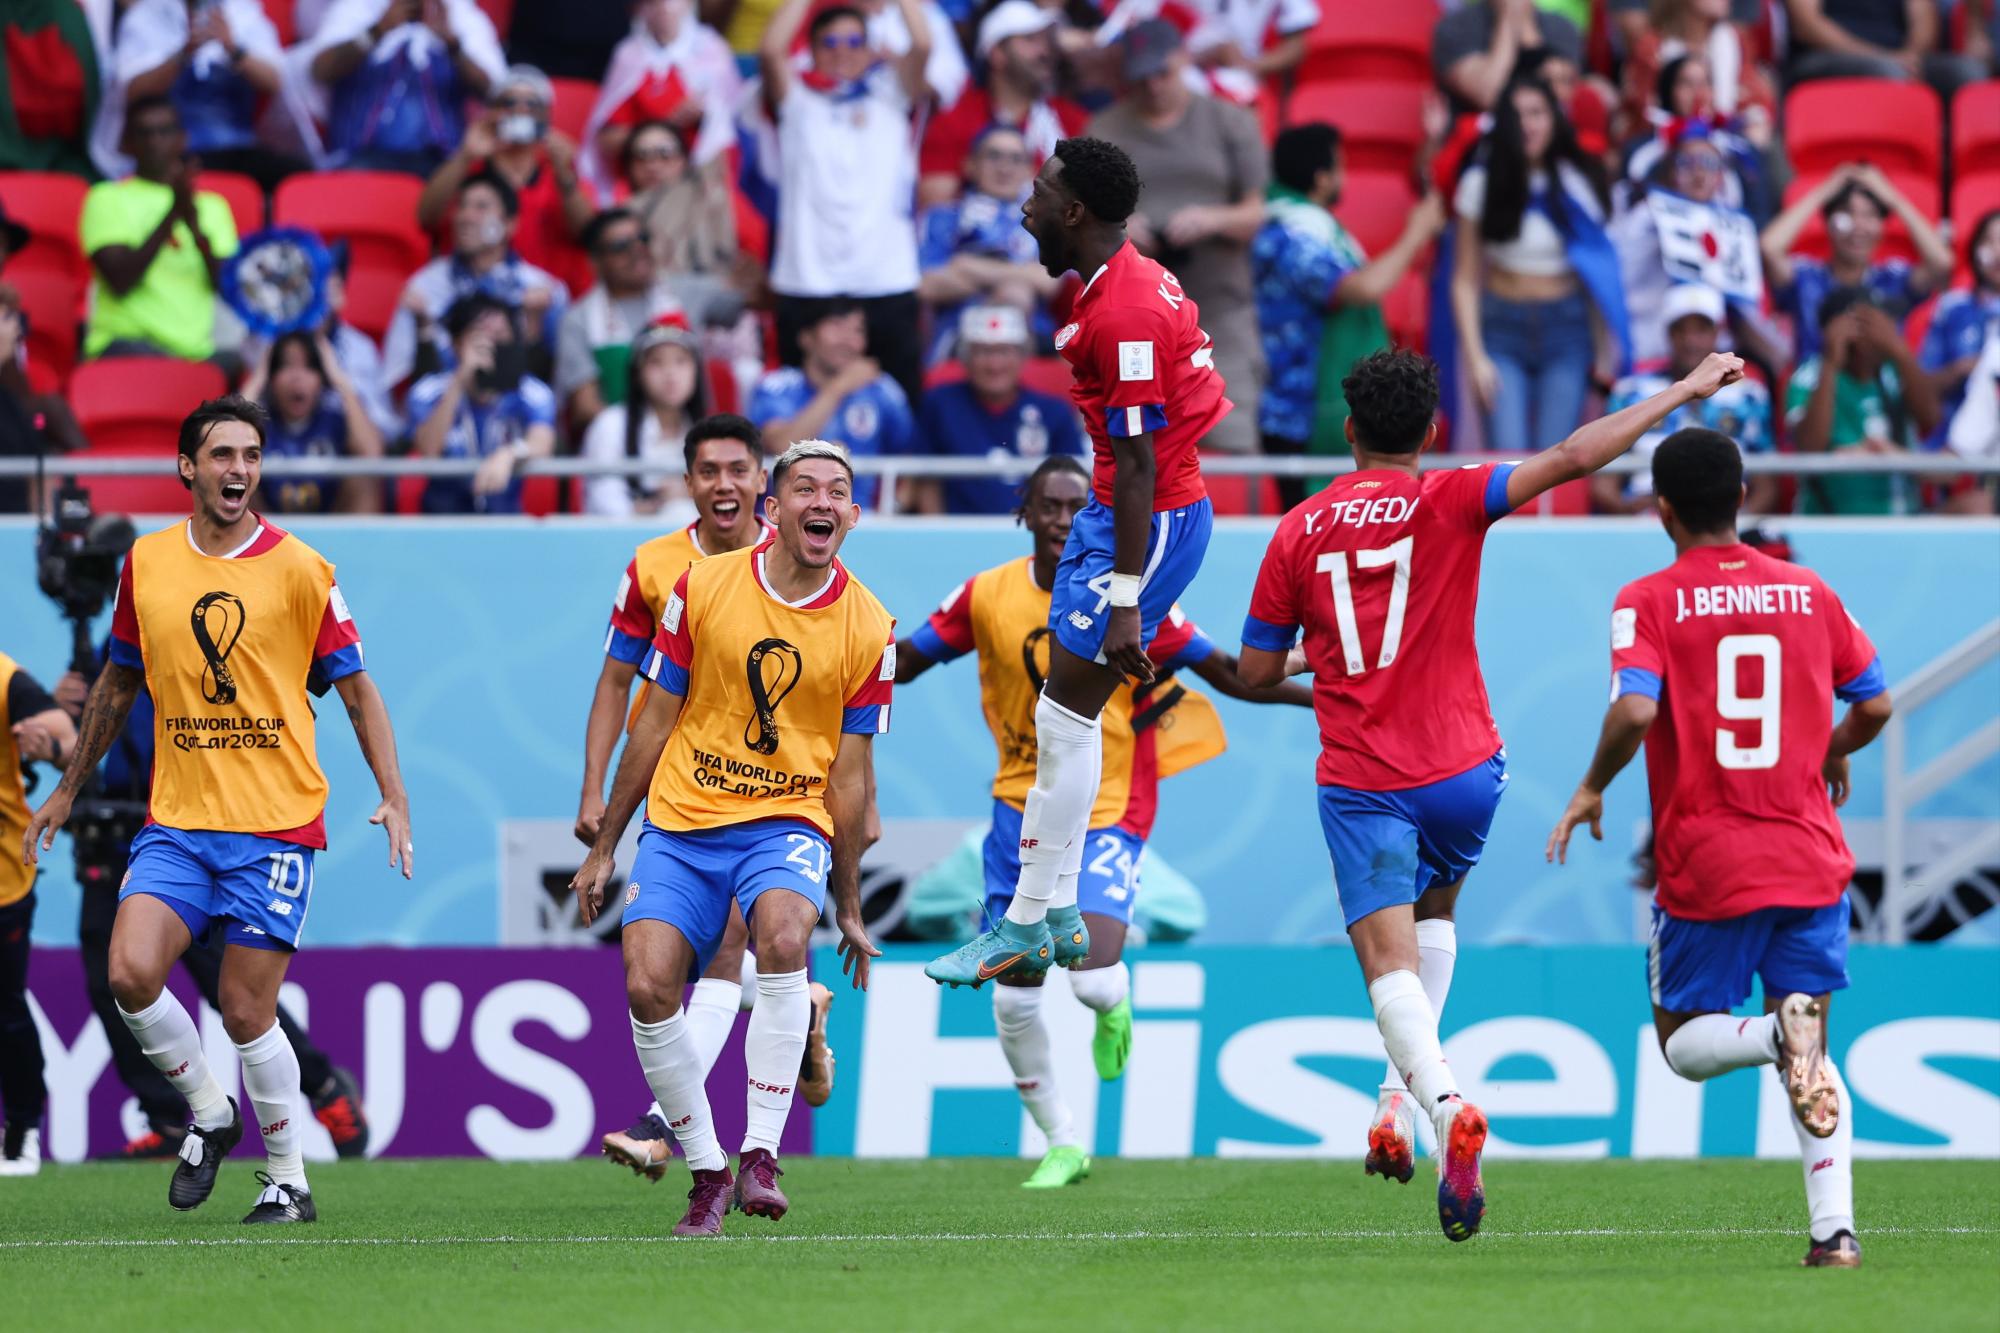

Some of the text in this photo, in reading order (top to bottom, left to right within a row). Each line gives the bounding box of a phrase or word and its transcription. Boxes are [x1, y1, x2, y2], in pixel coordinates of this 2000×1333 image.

[1304, 509, 1324, 535] Y.
[1087, 570, 1112, 615] 4
[1316, 535, 1414, 676] 17
[1675, 583, 1813, 623] J. BENNETTE
[1716, 633, 1782, 769] 9
[192, 717, 253, 731] WORLD
[255, 717, 286, 731] CUP
[693, 749, 822, 786] FIFA WORLD CUP
[268, 852, 304, 898] 10
[786, 834, 826, 876] 21
[748, 1078, 791, 1095] FCRF
